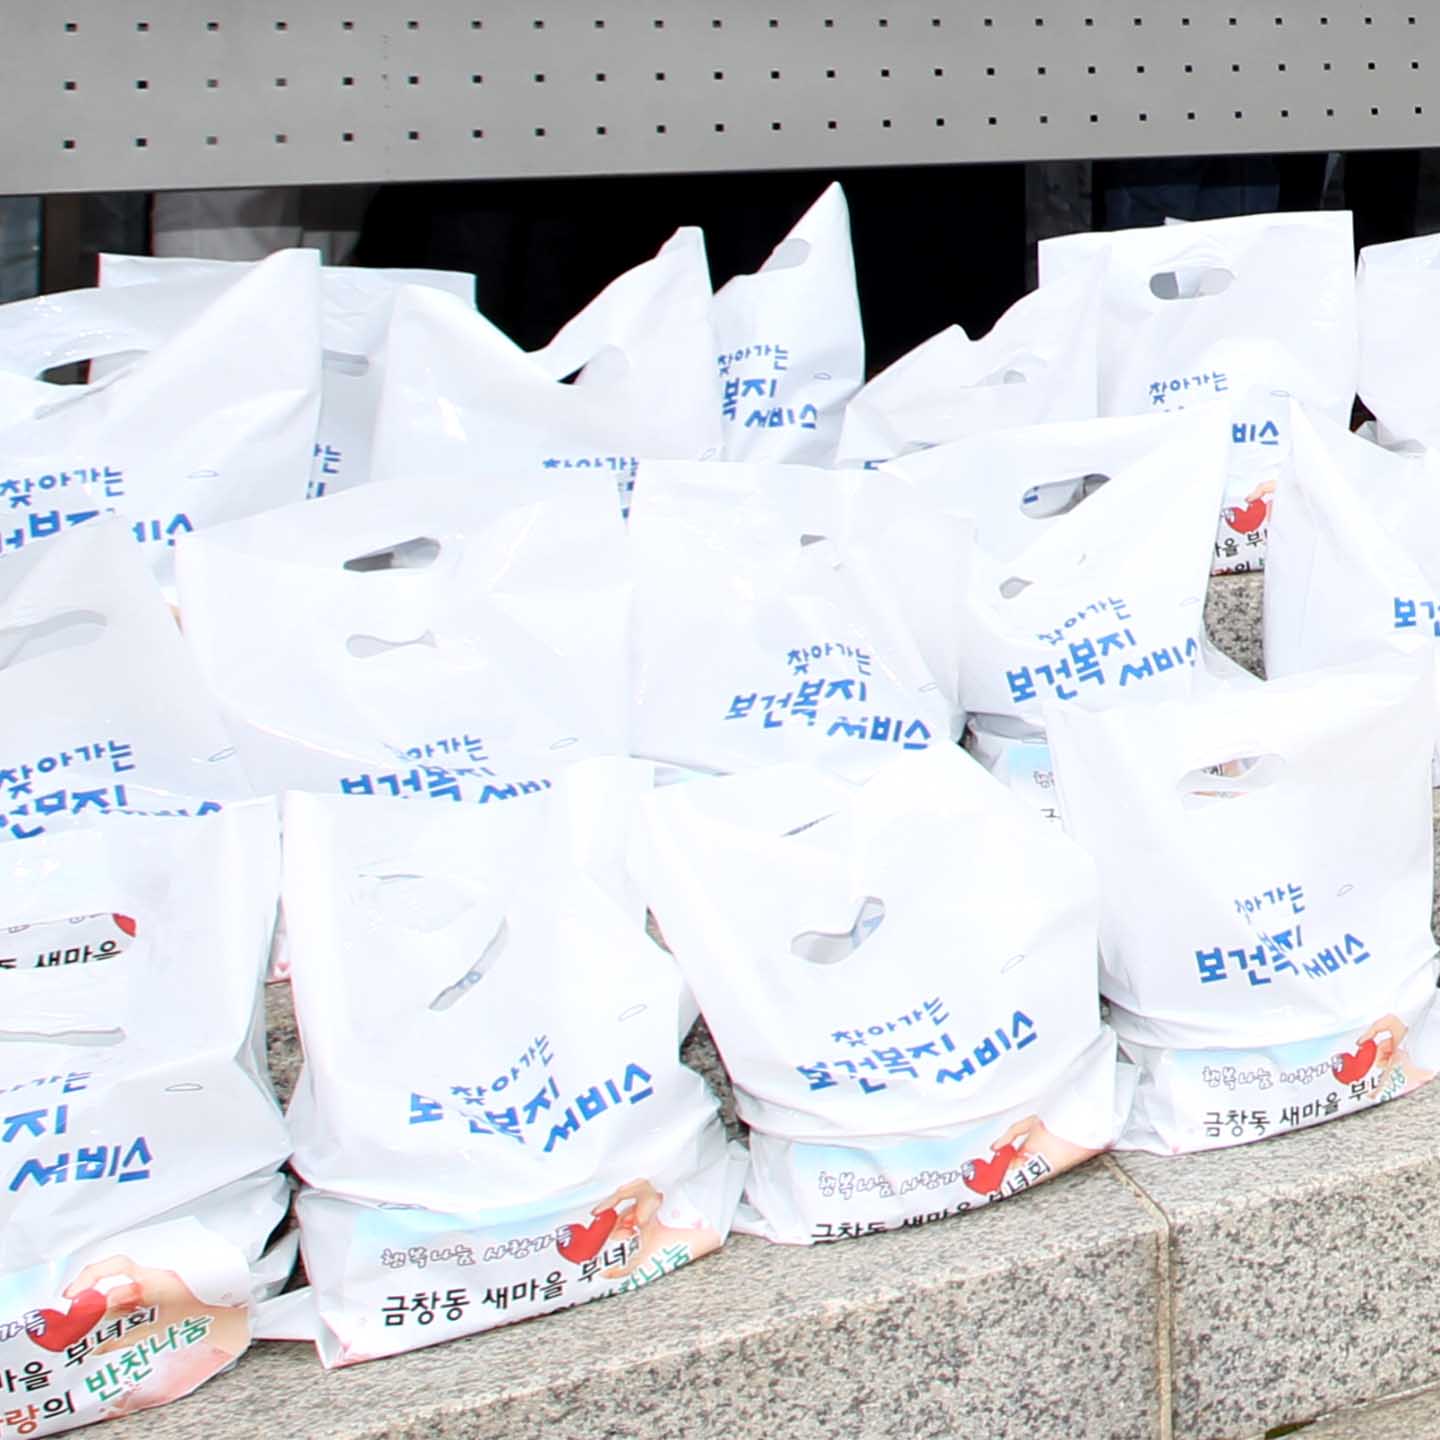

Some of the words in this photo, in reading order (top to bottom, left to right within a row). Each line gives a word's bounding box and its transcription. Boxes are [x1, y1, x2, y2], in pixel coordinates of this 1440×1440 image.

[1148, 371, 1230, 405] 찾아가는
[1232, 420, 1280, 446] 비스
[0, 465, 127, 509] 찾아가는
[786, 642, 872, 677] 찾아가는
[1005, 627, 1137, 704] 보건복지
[724, 678, 868, 730] 보건복지
[398, 734, 490, 762] 아가는
[826, 715, 932, 751] 서비스
[0, 739, 136, 799] 찾아가는
[831, 996, 951, 1049] 찾아가는
[451, 1034, 555, 1107] 찾아가는
[796, 1032, 957, 1095] 보건복지
[935, 1009, 1038, 1085] 서비스
[543, 1062, 654, 1153] 서비스
[1202, 1109, 1271, 1138] 금창동
[1279, 1091, 1343, 1127] 새마을
[8, 1136, 154, 1194] 서비스
[381, 1287, 471, 1328] 금창동
[481, 1270, 568, 1311] 새마을
[63, 1304, 161, 1368] 부녀회
[0, 1391, 76, 1438] 랑의
[84, 1313, 214, 1403] 반찬나눔
